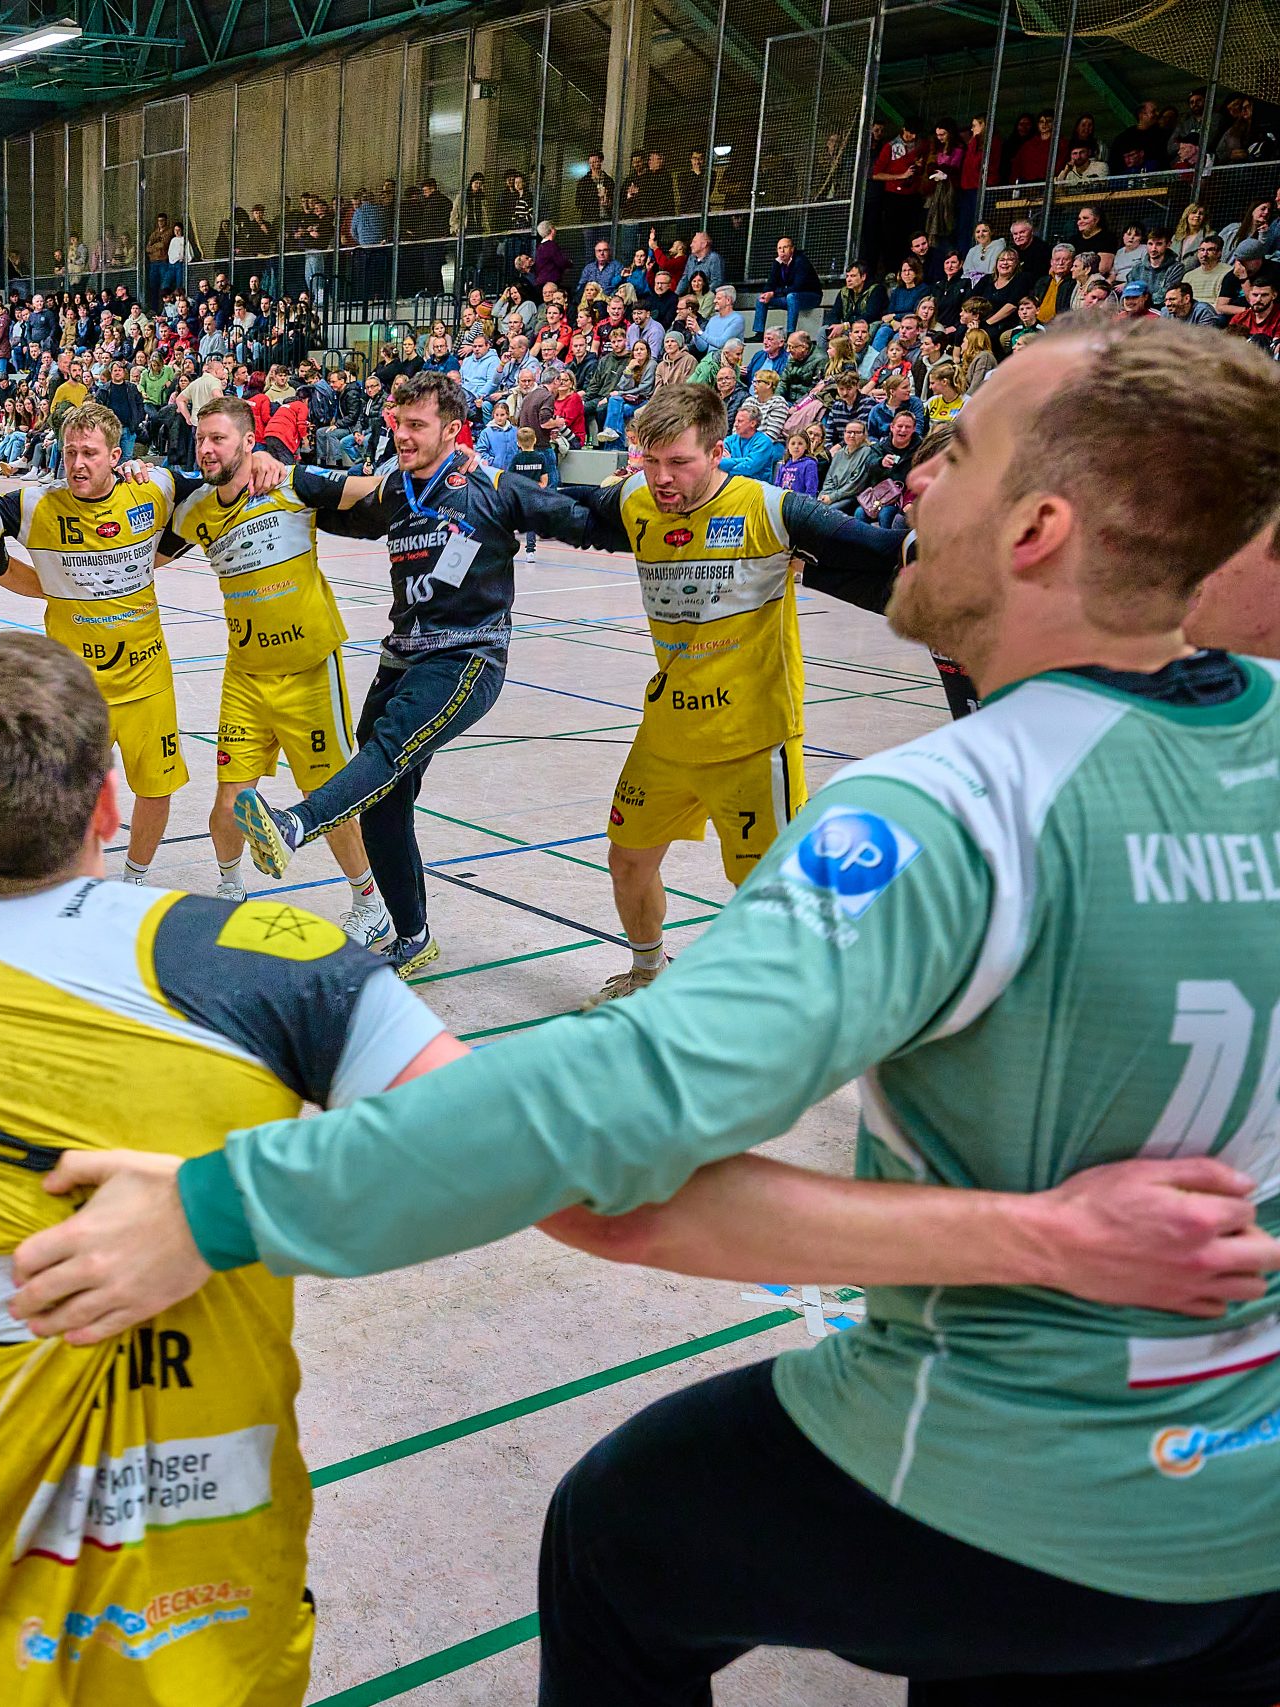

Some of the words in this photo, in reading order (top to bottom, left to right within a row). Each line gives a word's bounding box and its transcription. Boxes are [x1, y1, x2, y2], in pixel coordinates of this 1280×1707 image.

[57, 515, 85, 545] 15
[246, 516, 280, 535] GEISSER
[635, 518, 650, 552] 7
[708, 524, 743, 541] MERZ
[387, 530, 449, 554] ZENKNER
[61, 550, 133, 568] AUTOHAUSGRUPPE
[694, 565, 735, 580] GEISSER
[227, 617, 242, 634] BB
[257, 624, 305, 648] Bank
[82, 643, 106, 659] BB
[128, 639, 163, 668] Bank
[672, 686, 732, 711] Bank
[160, 732, 177, 758] 15
[310, 730, 326, 753] 8
[738, 811, 756, 840] 7
